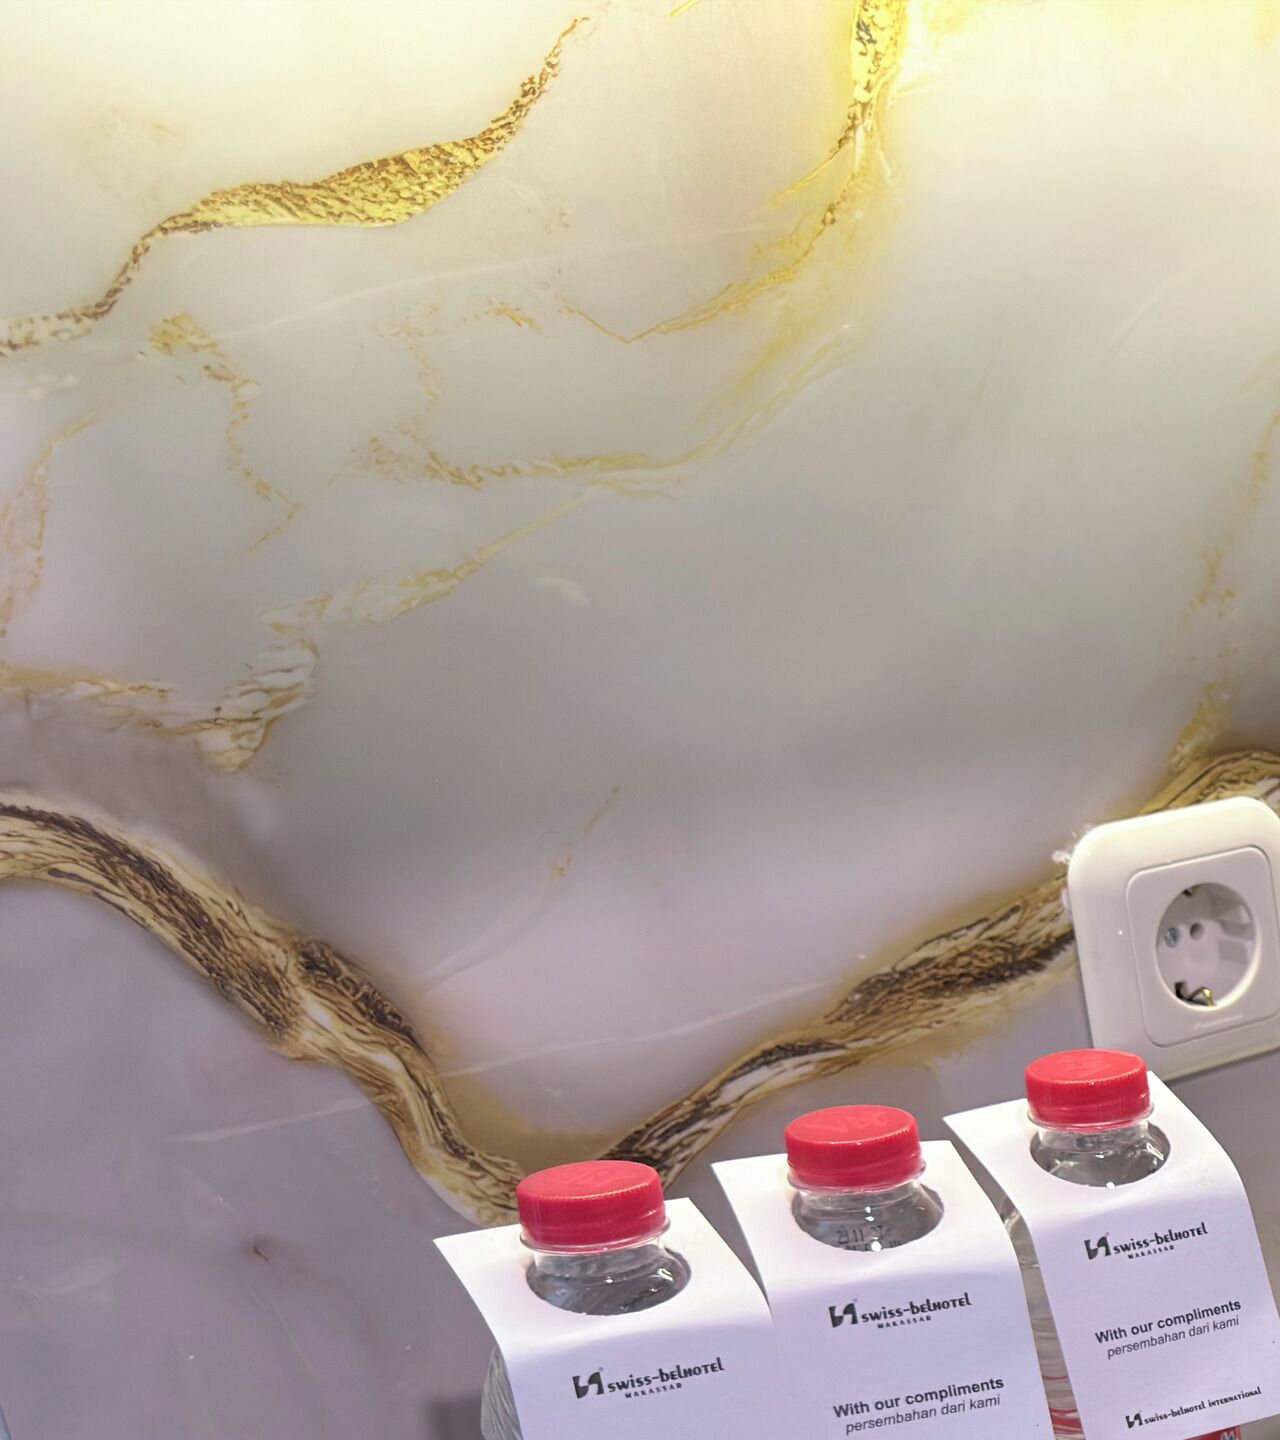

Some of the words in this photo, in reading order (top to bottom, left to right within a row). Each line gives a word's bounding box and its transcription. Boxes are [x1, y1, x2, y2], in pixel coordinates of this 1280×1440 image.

[1128, 1244, 1175, 1260] MAKASSAR
[877, 1315, 932, 1329] MAKASSAR
[1094, 1329, 1128, 1344] With
[1131, 1322, 1154, 1336] our
[1157, 1300, 1242, 1330] compliments
[1107, 1329, 1186, 1360] persembahan
[1188, 1322, 1211, 1338] dari
[1213, 1315, 1240, 1331] kami
[624, 1382, 683, 1399] MAKASSAR
[833, 1399, 870, 1418] With
[874, 1396, 901, 1411] our
[905, 1377, 1005, 1405] compliments
[845, 1406, 937, 1436] persembahan
[940, 1400, 966, 1416] dari
[969, 1394, 1001, 1411] kami
